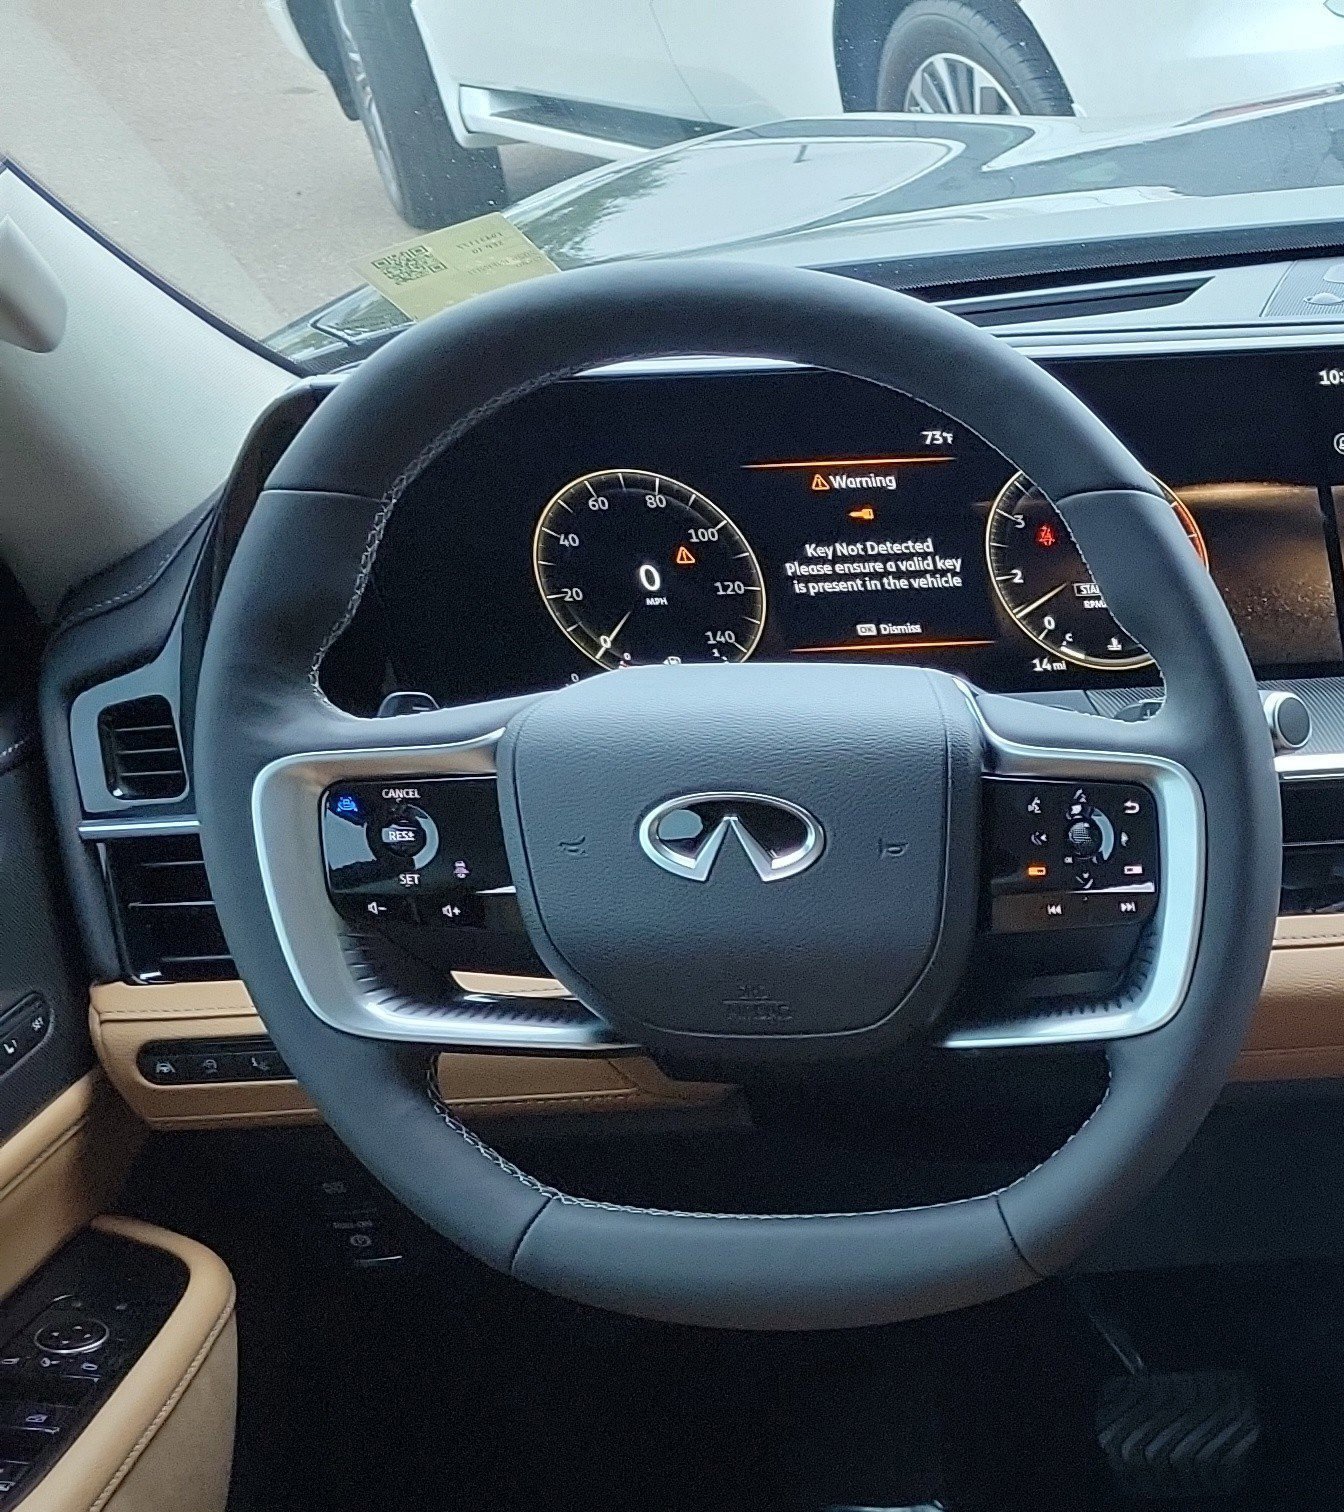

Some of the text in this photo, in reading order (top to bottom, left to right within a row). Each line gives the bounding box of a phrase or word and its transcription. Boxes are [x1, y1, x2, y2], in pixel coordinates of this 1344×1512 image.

[829, 474, 897, 490] Warning
[588, 497, 608, 510] 60
[645, 495, 666, 508] 80
[559, 534, 580, 547] 40
[688, 529, 718, 542] 100
[805, 538, 934, 559] Key Not Detected
[785, 556, 962, 576] Please ensure a valid key
[639, 565, 660, 591] 0
[1012, 569, 1024, 584] 2
[714, 581, 745, 595] 120
[793, 574, 962, 596] is present in the vehicle
[564, 588, 584, 601] 20
[646, 597, 668, 606] MPH
[879, 623, 922, 634] Dismiss
[1044, 616, 1056, 630] 0
[600, 635, 612, 648] 0
[705, 630, 736, 644] 140
[1032, 660, 1067, 672] 14 mi
[382, 788, 420, 798] CANCEL
